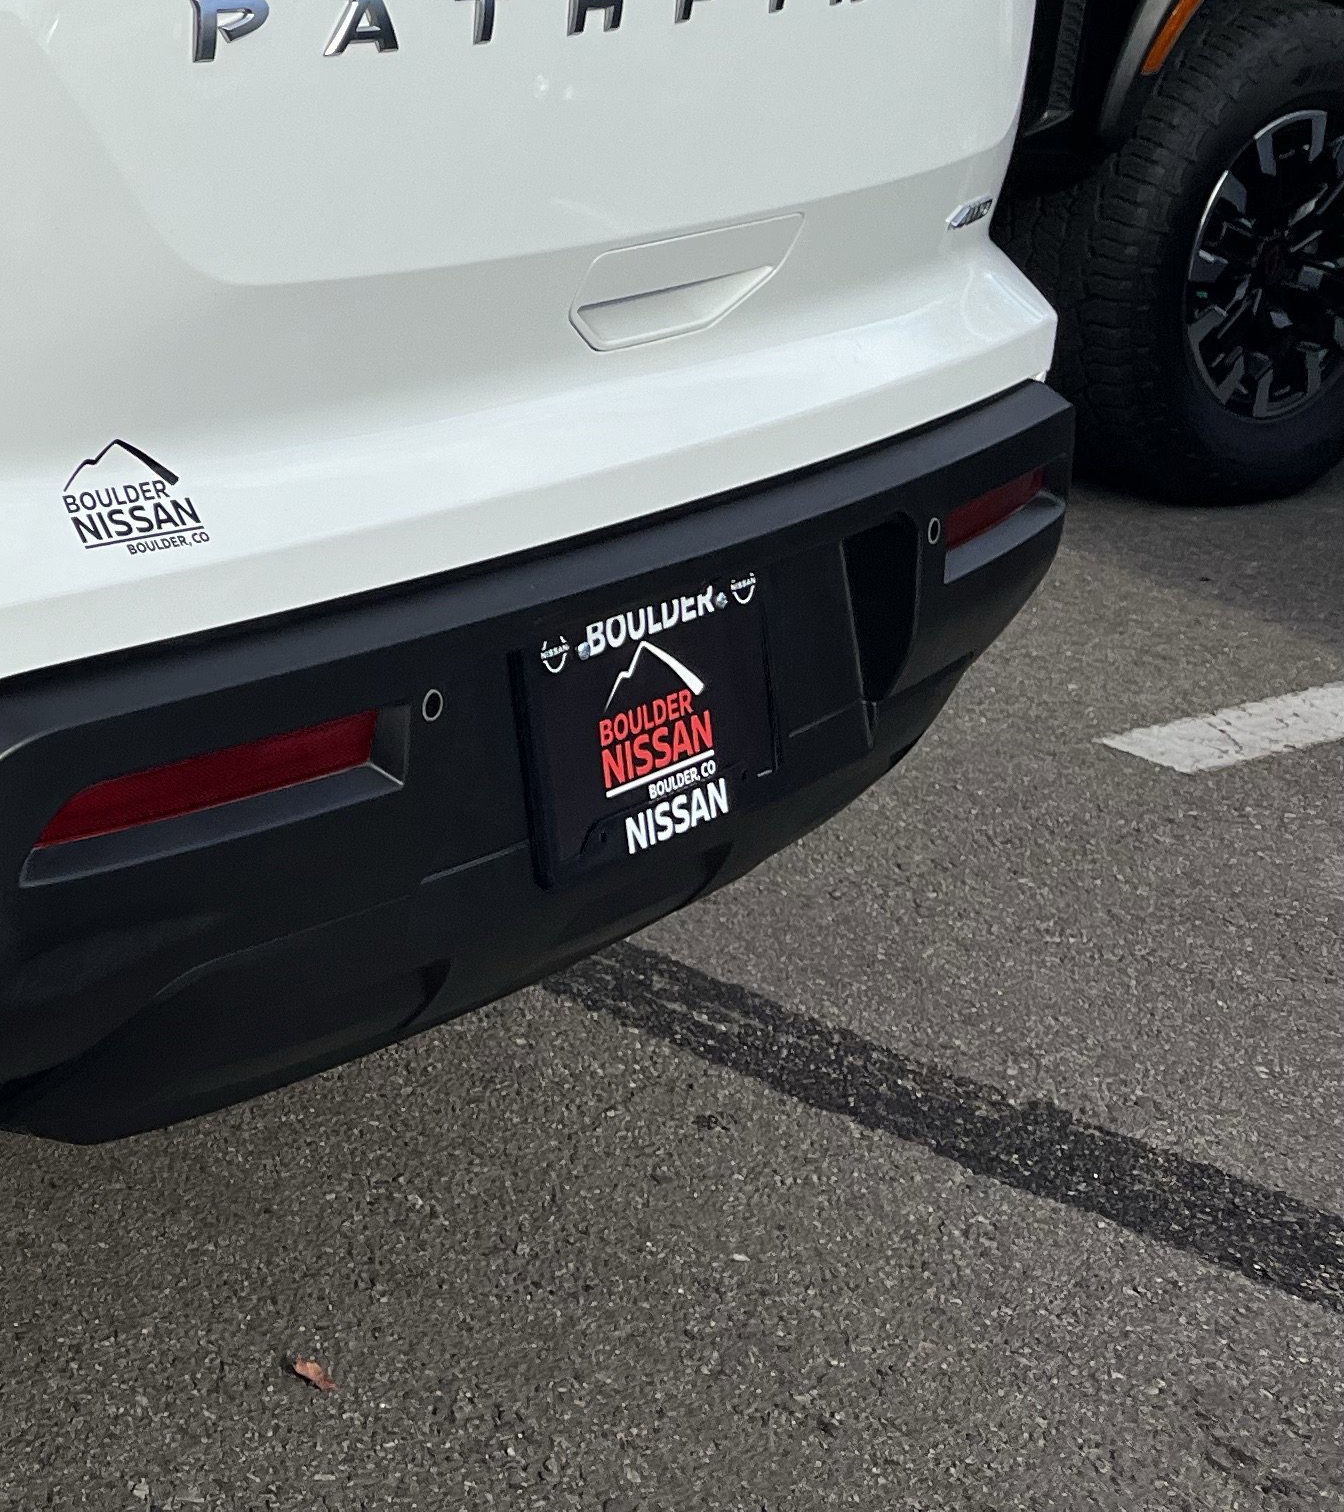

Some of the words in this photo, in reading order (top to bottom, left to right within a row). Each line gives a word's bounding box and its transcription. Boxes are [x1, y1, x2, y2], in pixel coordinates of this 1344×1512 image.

[62, 480, 170, 514] BOULDER
[71, 497, 202, 543] NISSAN
[126, 535, 193, 555] BOULDER,
[191, 532, 210, 544] CO
[586, 585, 715, 657] BOULDER
[599, 689, 693, 747] BOULDER
[601, 710, 713, 788] NISSAN
[648, 766, 701, 800] BOULDER,
[700, 759, 716, 778] CO
[625, 778, 729, 854] NISSAN
